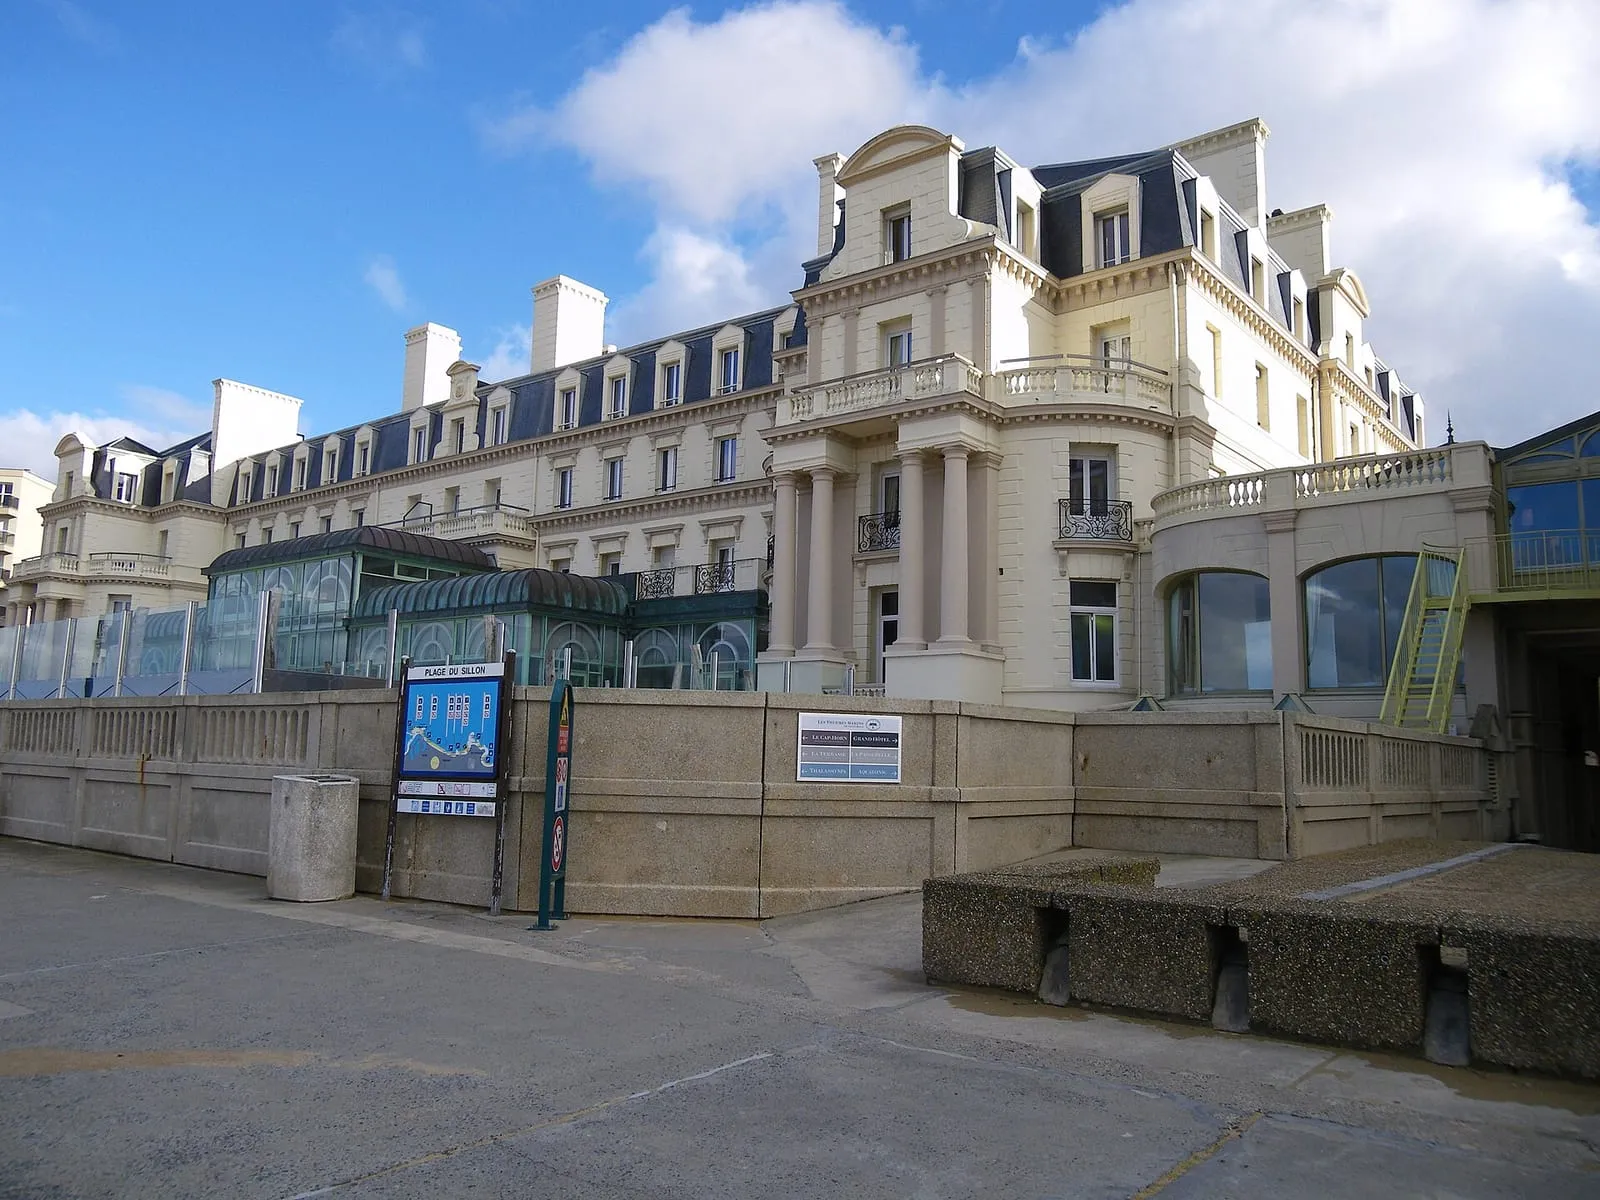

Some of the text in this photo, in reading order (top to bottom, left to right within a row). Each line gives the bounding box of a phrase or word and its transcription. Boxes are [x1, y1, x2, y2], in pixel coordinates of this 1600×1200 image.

[424, 666, 486, 677] PLAGE DU SILLON
